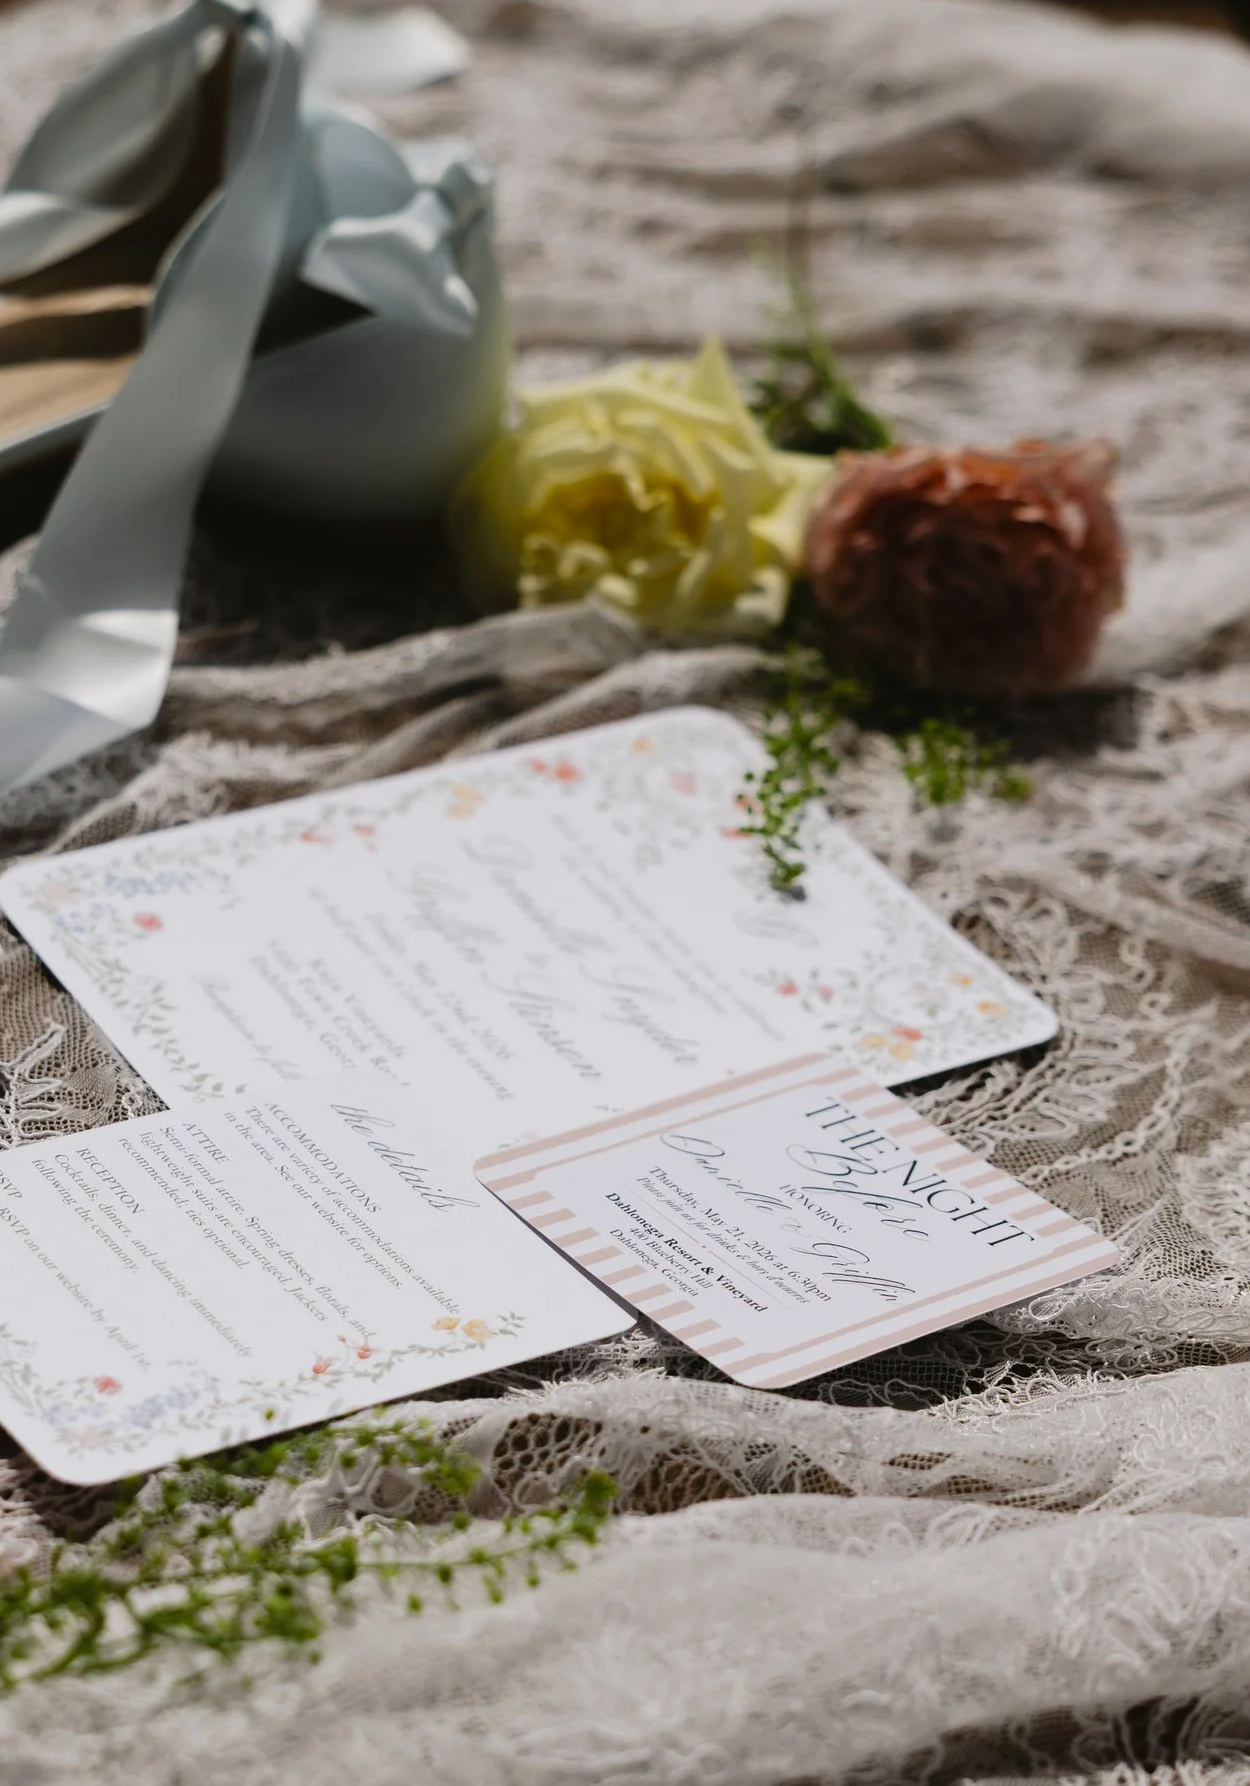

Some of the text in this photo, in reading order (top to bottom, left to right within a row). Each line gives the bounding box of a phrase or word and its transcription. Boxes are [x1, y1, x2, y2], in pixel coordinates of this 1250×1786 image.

[74, 1147, 146, 1214] RECEPTION
[181, 1122, 230, 1164] ATTIRE
[263, 1103, 382, 1213] ACCOMMODATIONS
[329, 1103, 481, 1213] the details
[635, 1176, 666, 1200] Please
[785, 1142, 929, 1242] Before
[803, 1095, 1035, 1246] THE NIGHT
[29, 1159, 139, 1273] following the ceremony.
[53, 1153, 253, 1357] Cocktails, dinner, and dancing immediately
[117, 1137, 250, 1270] recommended; ties optional.
[138, 1131, 328, 1321] lightweight suits are encouraged. Jackets
[159, 1126, 377, 1338] Semi-formal attire. Spring dresses, florals, and
[222, 1111, 403, 1290] in the area. See our website for options.
[244, 1105, 460, 1314] There are variety of accommodations available
[603, 1192, 664, 1238] Dahlonega
[662, 1237, 702, 1266] Resort
[715, 1274, 768, 1312] Vineyard
[648, 1165, 831, 1301] Thursday, May 21, 2026 at 6:30pm
[656, 1199, 684, 1212] join
[659, 1133, 791, 1212] Danielle
[789, 1241, 917, 1302] Griffin
[679, 1213, 696, 1223] us
[687, 1221, 710, 1231] for
[705, 1232, 739, 1253] drinks
[778, 1183, 852, 1233] HONORING
[22, 1238, 40, 1252] on
[36, 1252, 59, 1270] our
[54, 1271, 93, 1308] website
[89, 1308, 108, 1322] by
[103, 1325, 139, 1350] April
[608, 1228, 699, 1296] Dahlonega, Georgia
[629, 1227, 714, 1289] 400 Blueberry Hill
